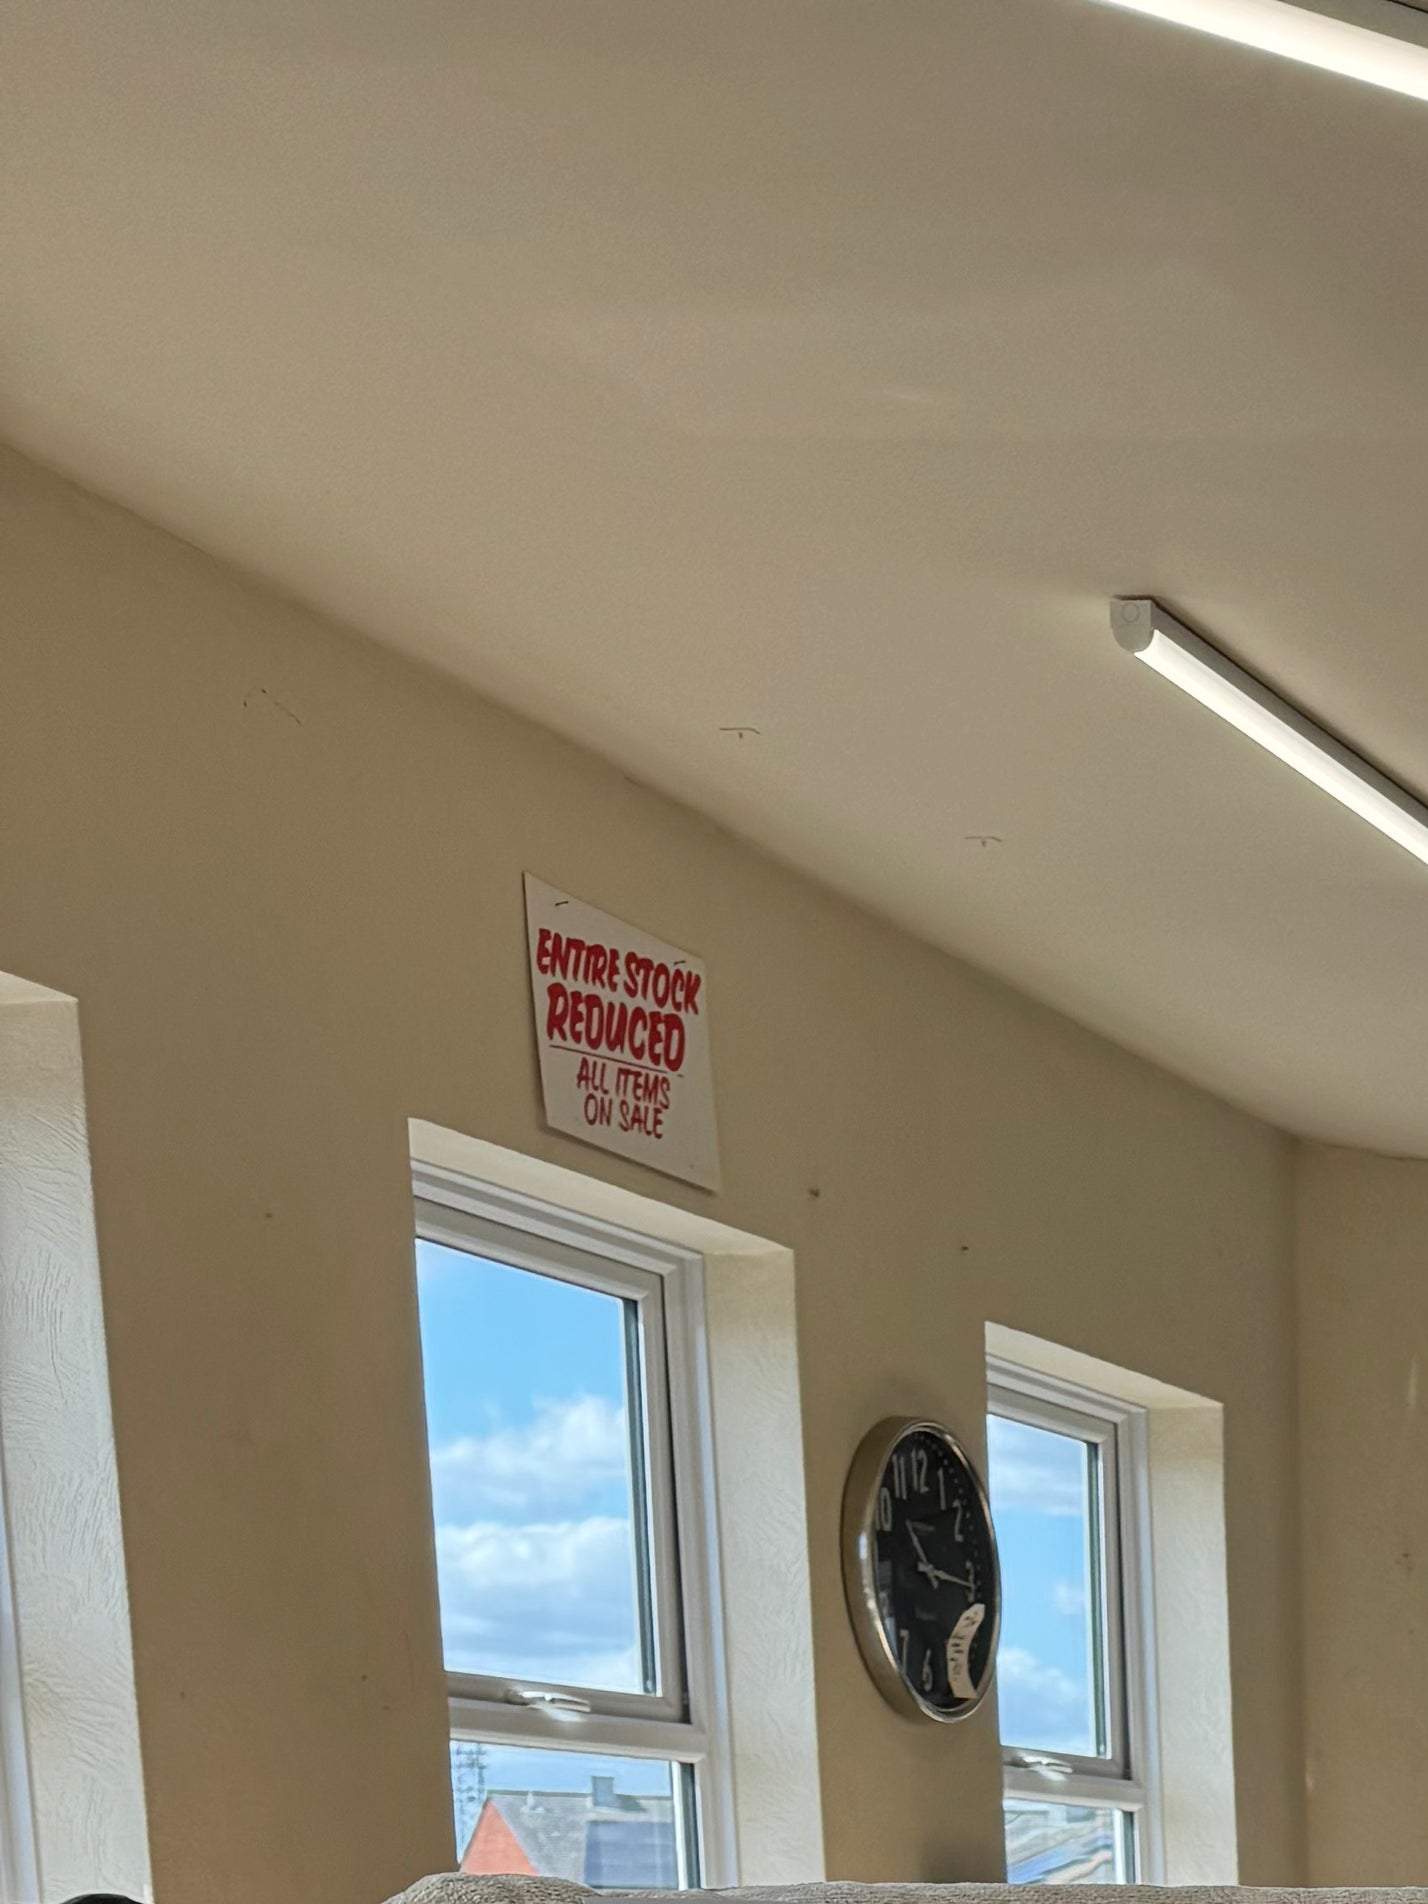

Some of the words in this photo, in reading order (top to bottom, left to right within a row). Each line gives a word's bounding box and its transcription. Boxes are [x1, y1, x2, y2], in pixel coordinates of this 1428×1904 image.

[536, 928, 619, 992] ENTIRE
[624, 951, 702, 1015] STOCK
[547, 981, 685, 1072] REDUCED
[577, 1057, 609, 1092] ALL
[615, 1068, 670, 1110] ITEMS
[584, 1094, 612, 1127] ON
[618, 1101, 664, 1139] SALE
[911, 1448, 929, 1493] 12
[952, 1499, 964, 1542] 2
